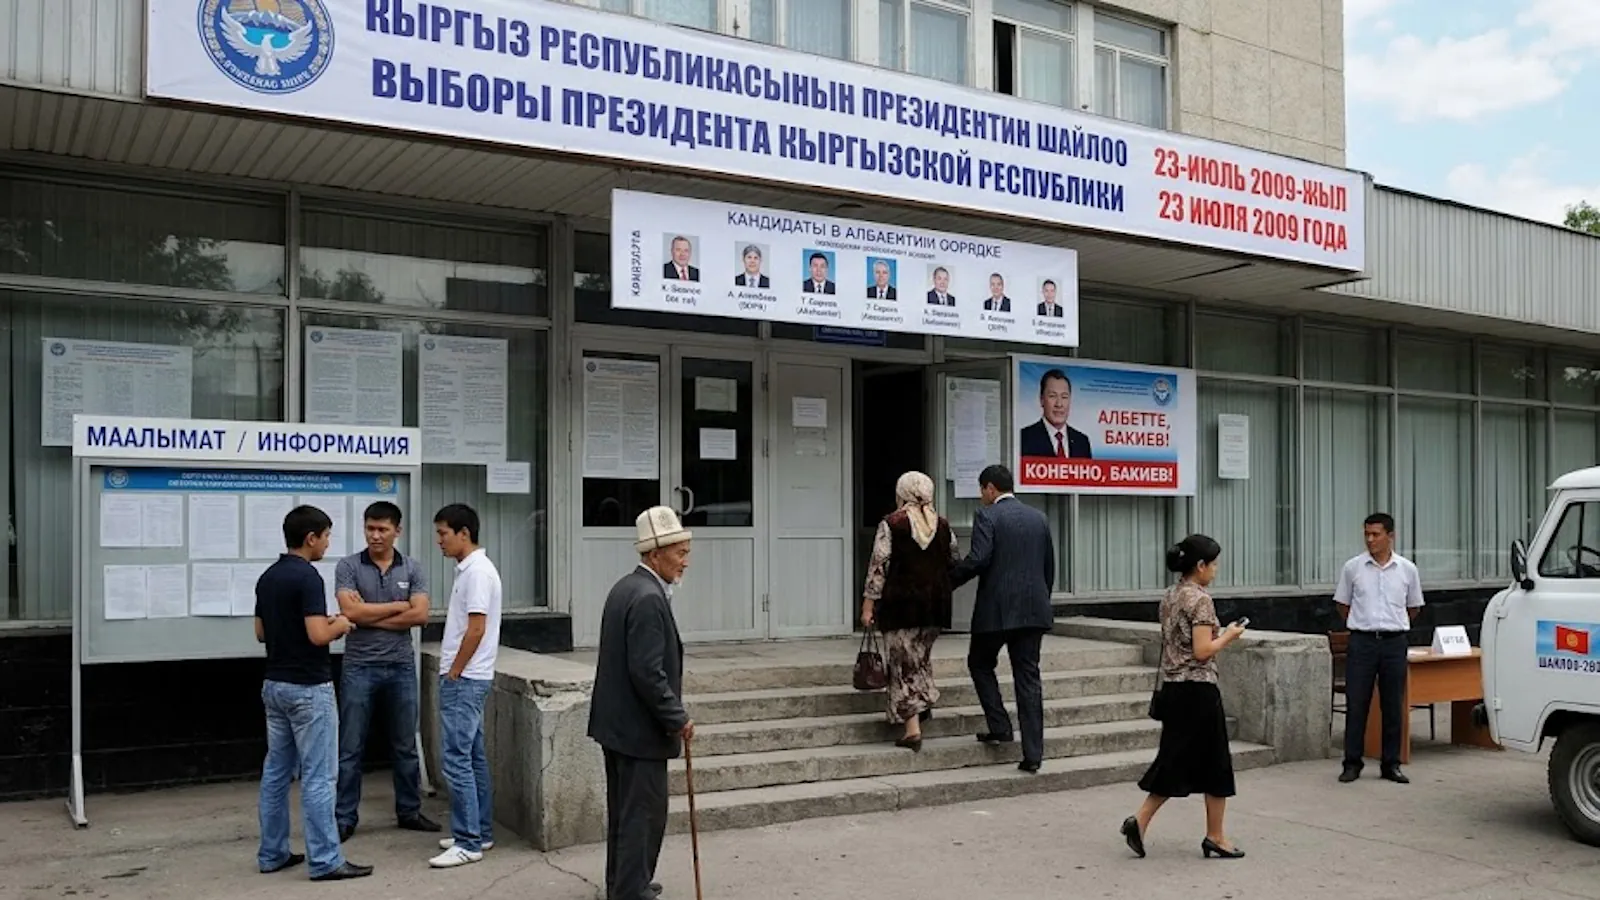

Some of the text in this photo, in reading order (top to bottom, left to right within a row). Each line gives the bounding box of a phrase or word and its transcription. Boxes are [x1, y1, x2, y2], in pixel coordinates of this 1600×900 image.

[366, 0, 1128, 167] КЫРГЫЗ РЕСПУБЛИКАСЫНЫН ПРЕЗИДЕНТИН ШАЙЛОО
[372, 58, 551, 122] ВЫБОРЫ
[562, 88, 770, 155] ПРЕЗИДЕНТА
[780, 124, 972, 188] КЫРГЫЗСКОЙ
[979, 160, 1125, 213] РЕСПУБЛИКИ
[1154, 147, 1347, 212] 23-ИЮЛЬ 2009-ЖЫЛ
[727, 210, 826, 236] КАНДИДАТЫ
[832, 225, 841, 238] В
[1158, 190, 1348, 252] 23 ИЮЛЯ 2009 ГОДА
[1098, 409, 1171, 430] АЛБЕТТЕ,
[87, 426, 409, 457] МААЛЫМАТ / ИНФОРМАЦИЯ
[1105, 430, 1170, 447] БАКИЕВ!
[1025, 463, 1173, 483] КОНЕЧНО, БАКИЕВ!
